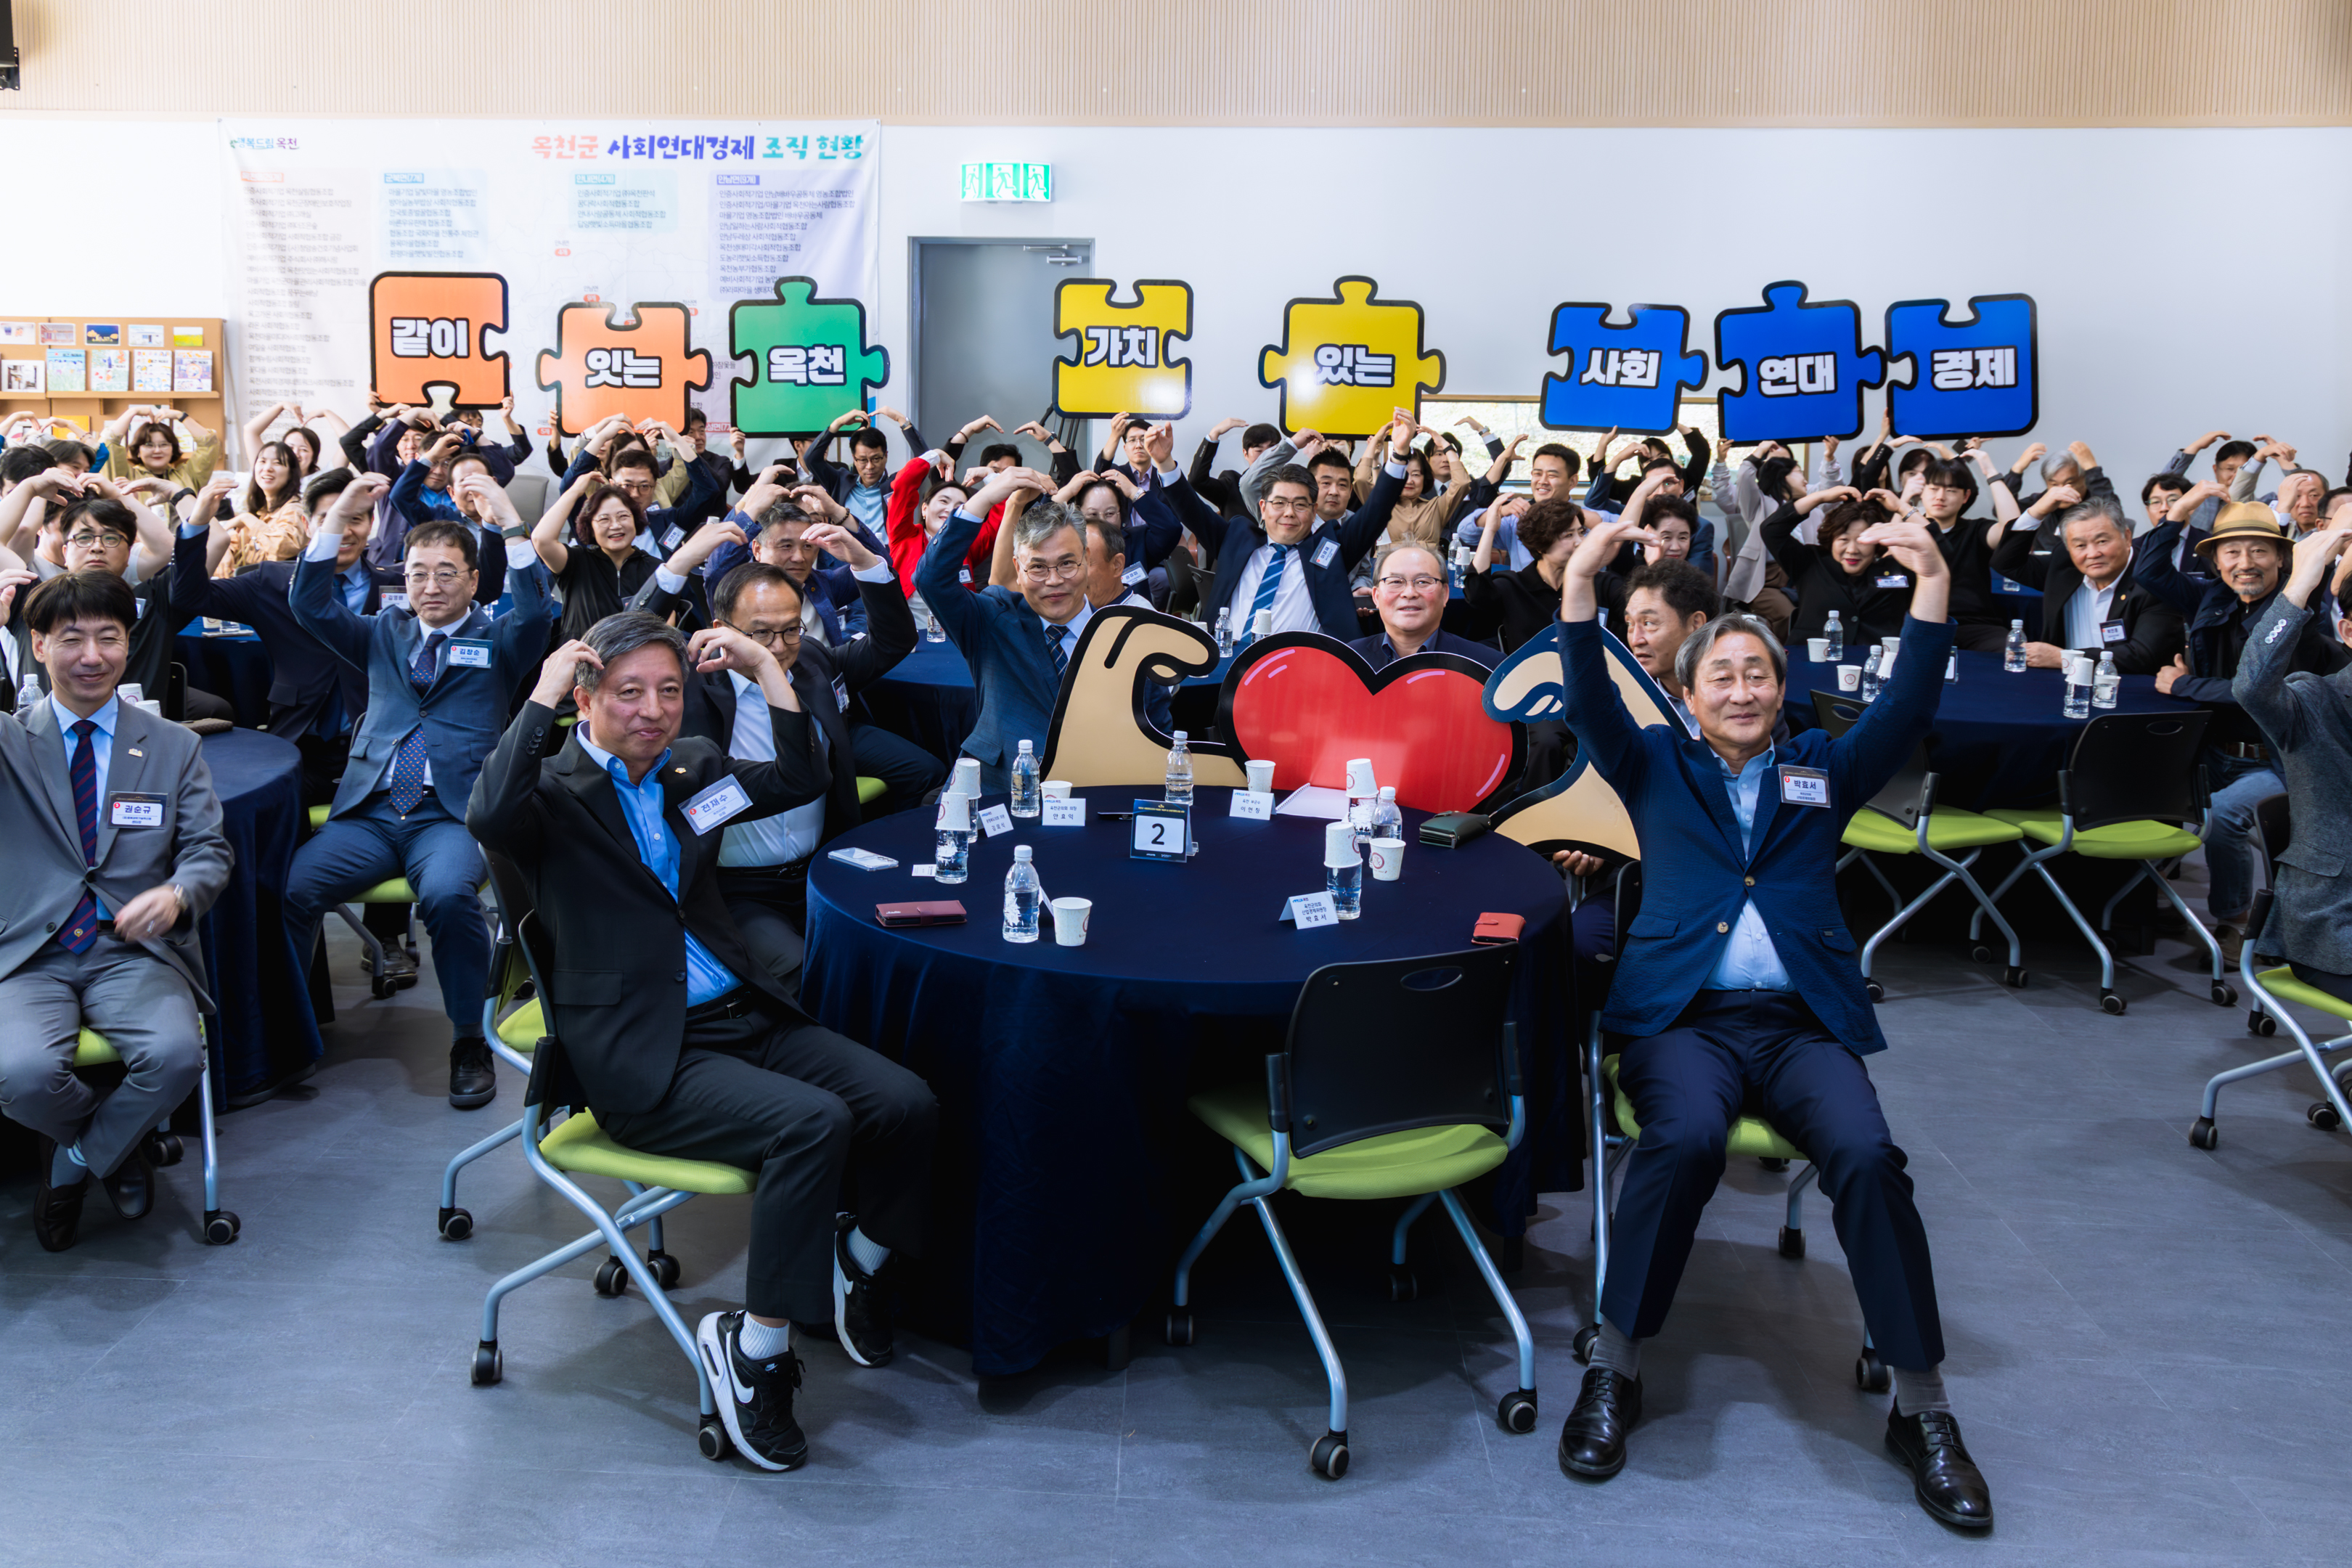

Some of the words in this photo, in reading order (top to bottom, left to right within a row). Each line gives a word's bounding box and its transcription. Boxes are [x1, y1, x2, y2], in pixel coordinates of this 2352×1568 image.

[237, 137, 274, 149] 행복드림
[276, 137, 299, 150] 옥천
[531, 135, 599, 159] 옥천군
[608, 134, 754, 160] 사회연대경제
[763, 135, 809, 160] 조직
[817, 135, 864, 160] 현황
[718, 175, 756, 184] 안남면(9개)
[793, 200, 855, 209] 옥천아는사람협동조합
[816, 189, 854, 198] 영농조합법인
[393, 319, 467, 356] 같이
[1086, 328, 1156, 365] 가치
[587, 350, 659, 386] 잇는
[769, 346, 844, 383] 옥천
[1317, 347, 1392, 386] 있는
[1582, 350, 1659, 386] 사회
[1760, 355, 1835, 394] 연대
[1935, 348, 2014, 388] 경제
[1794, 780, 1816, 790] 박효서
[125, 804, 151, 814] 권순규
[701, 794, 728, 814] 전재수
[1151, 822, 1165, 845] 2
[1302, 907, 1327, 915] 산업경제위원장
[1306, 914, 1327, 923] 박효서
